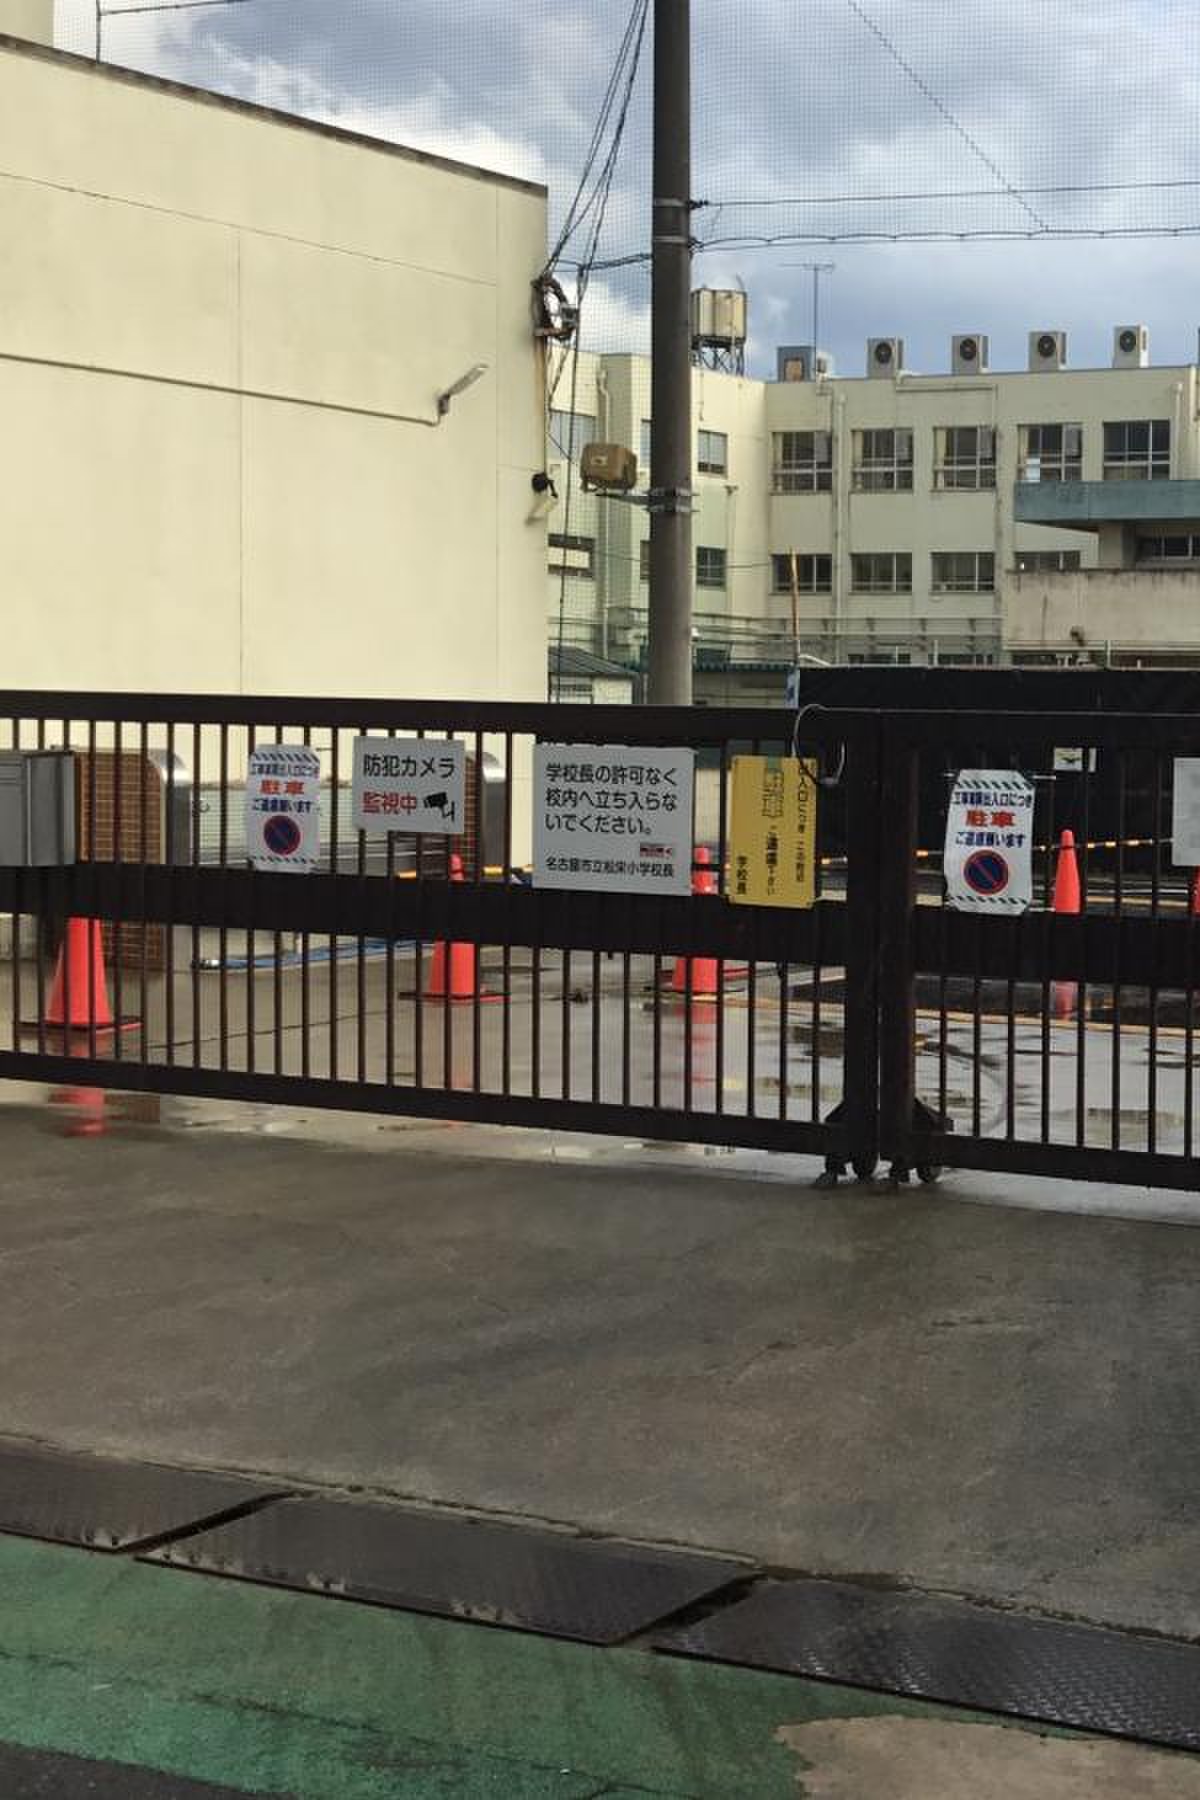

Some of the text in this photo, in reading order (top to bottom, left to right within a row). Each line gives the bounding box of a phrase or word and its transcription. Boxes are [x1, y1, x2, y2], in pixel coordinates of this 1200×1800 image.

[362, 753, 456, 779] 防犯カメラ
[545, 763, 677, 786] 学校長の許可なく
[260, 779, 305, 796] 駐車
[362, 791, 417, 815] 監視中
[545, 787, 677, 812] 校内へ立ち入らな
[965, 810, 1016, 828] 駐車
